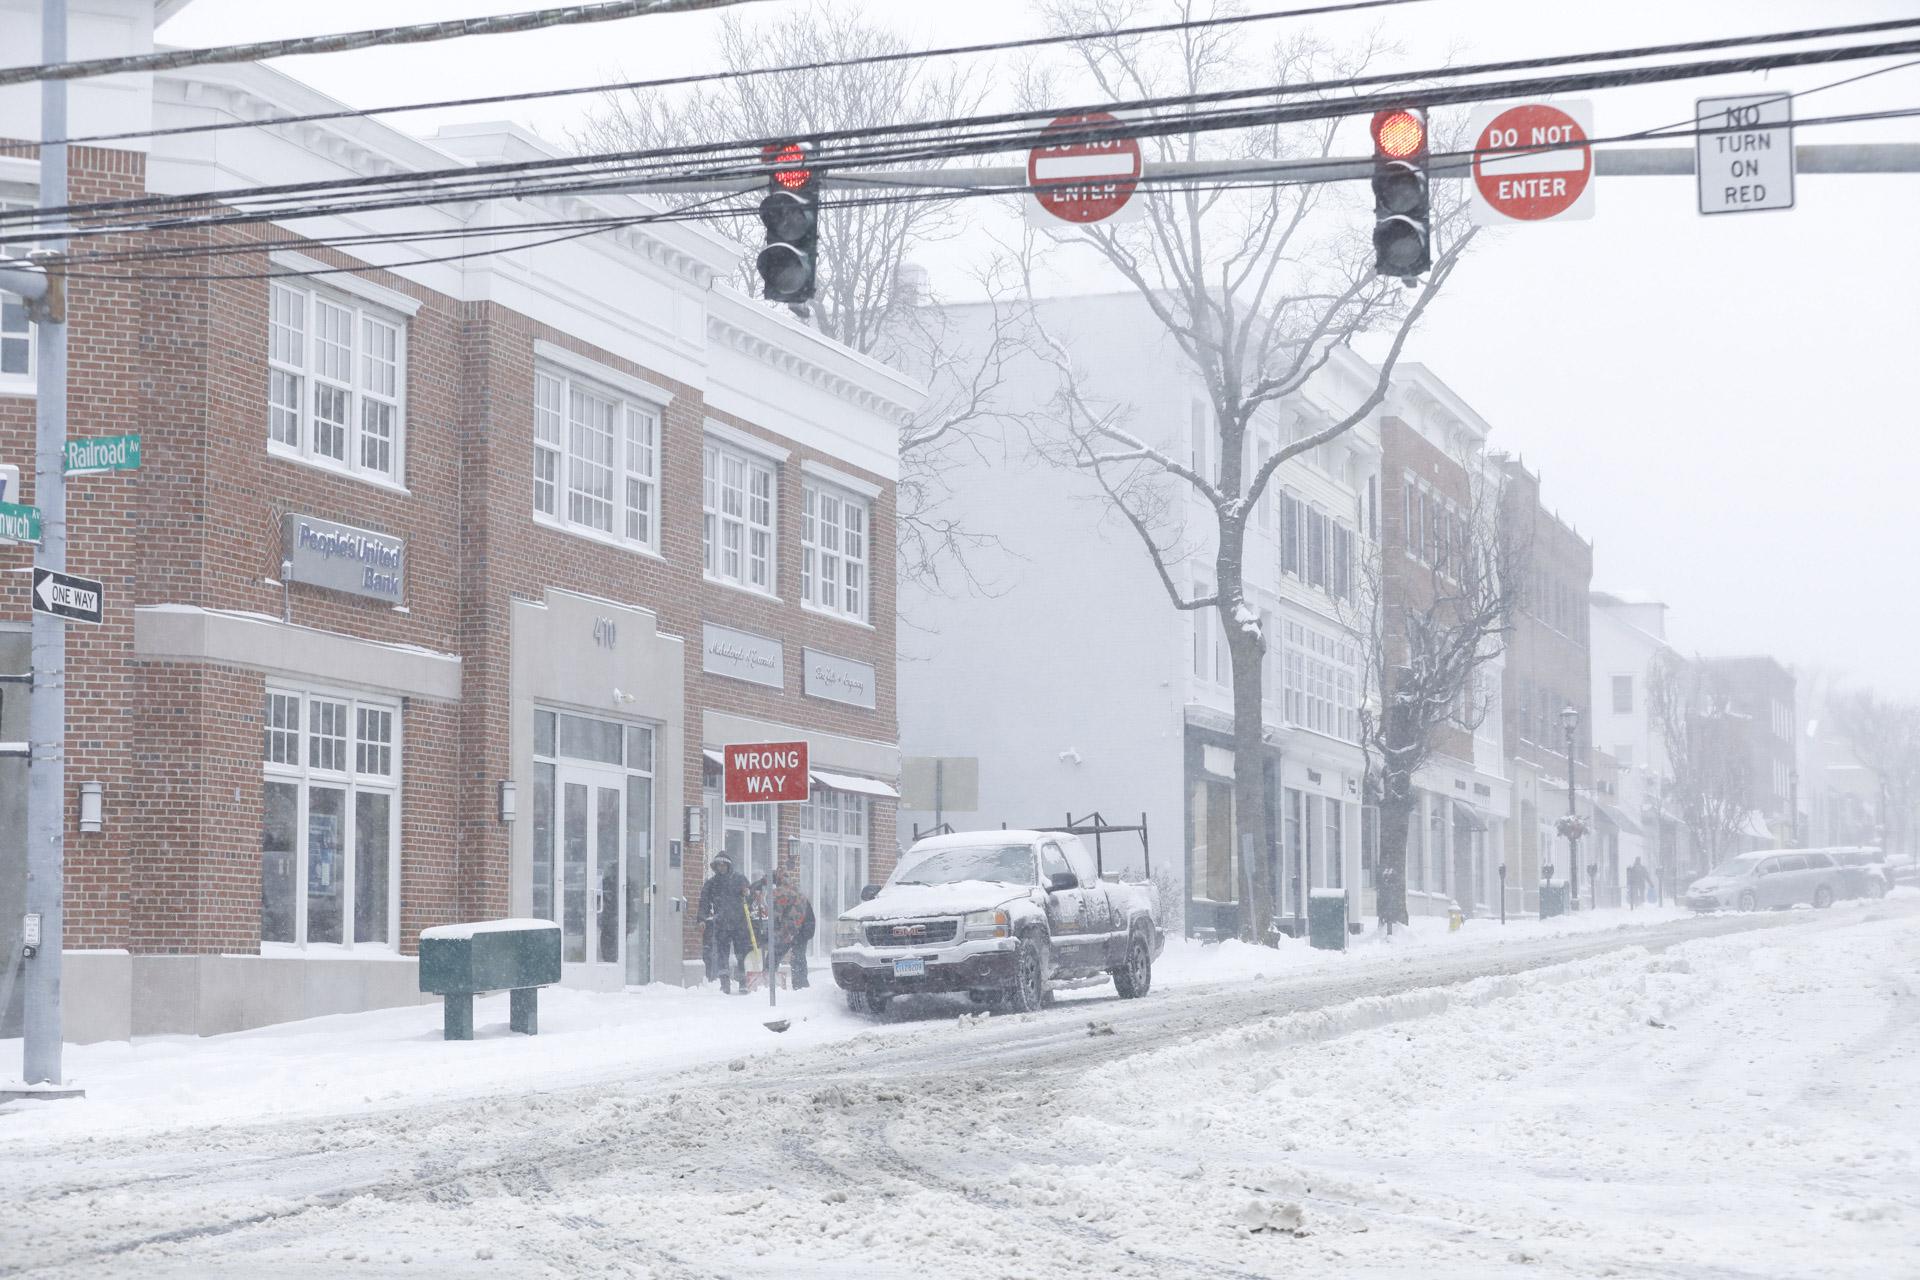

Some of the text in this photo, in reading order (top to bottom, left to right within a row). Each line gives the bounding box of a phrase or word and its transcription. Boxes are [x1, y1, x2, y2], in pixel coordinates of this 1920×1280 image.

[1724, 105, 1762, 128] NO
[1489, 123, 1573, 148] DO NOT
[1716, 132, 1771, 152] TURN
[1730, 158, 1760, 178] ON
[1498, 178, 1567, 201] ENTER
[1725, 184, 1767, 205] RED
[69, 438, 139, 468] Railroad Av
[31, 509, 41, 520] Av
[356, 536, 401, 569] United
[363, 565, 399, 595] Bank
[52, 585, 95, 609] ONE WAY
[592, 615, 616, 649] 410
[733, 751, 799, 771] WRONG
[746, 774, 786, 795] WAY
[893, 924, 927, 937] GMC
